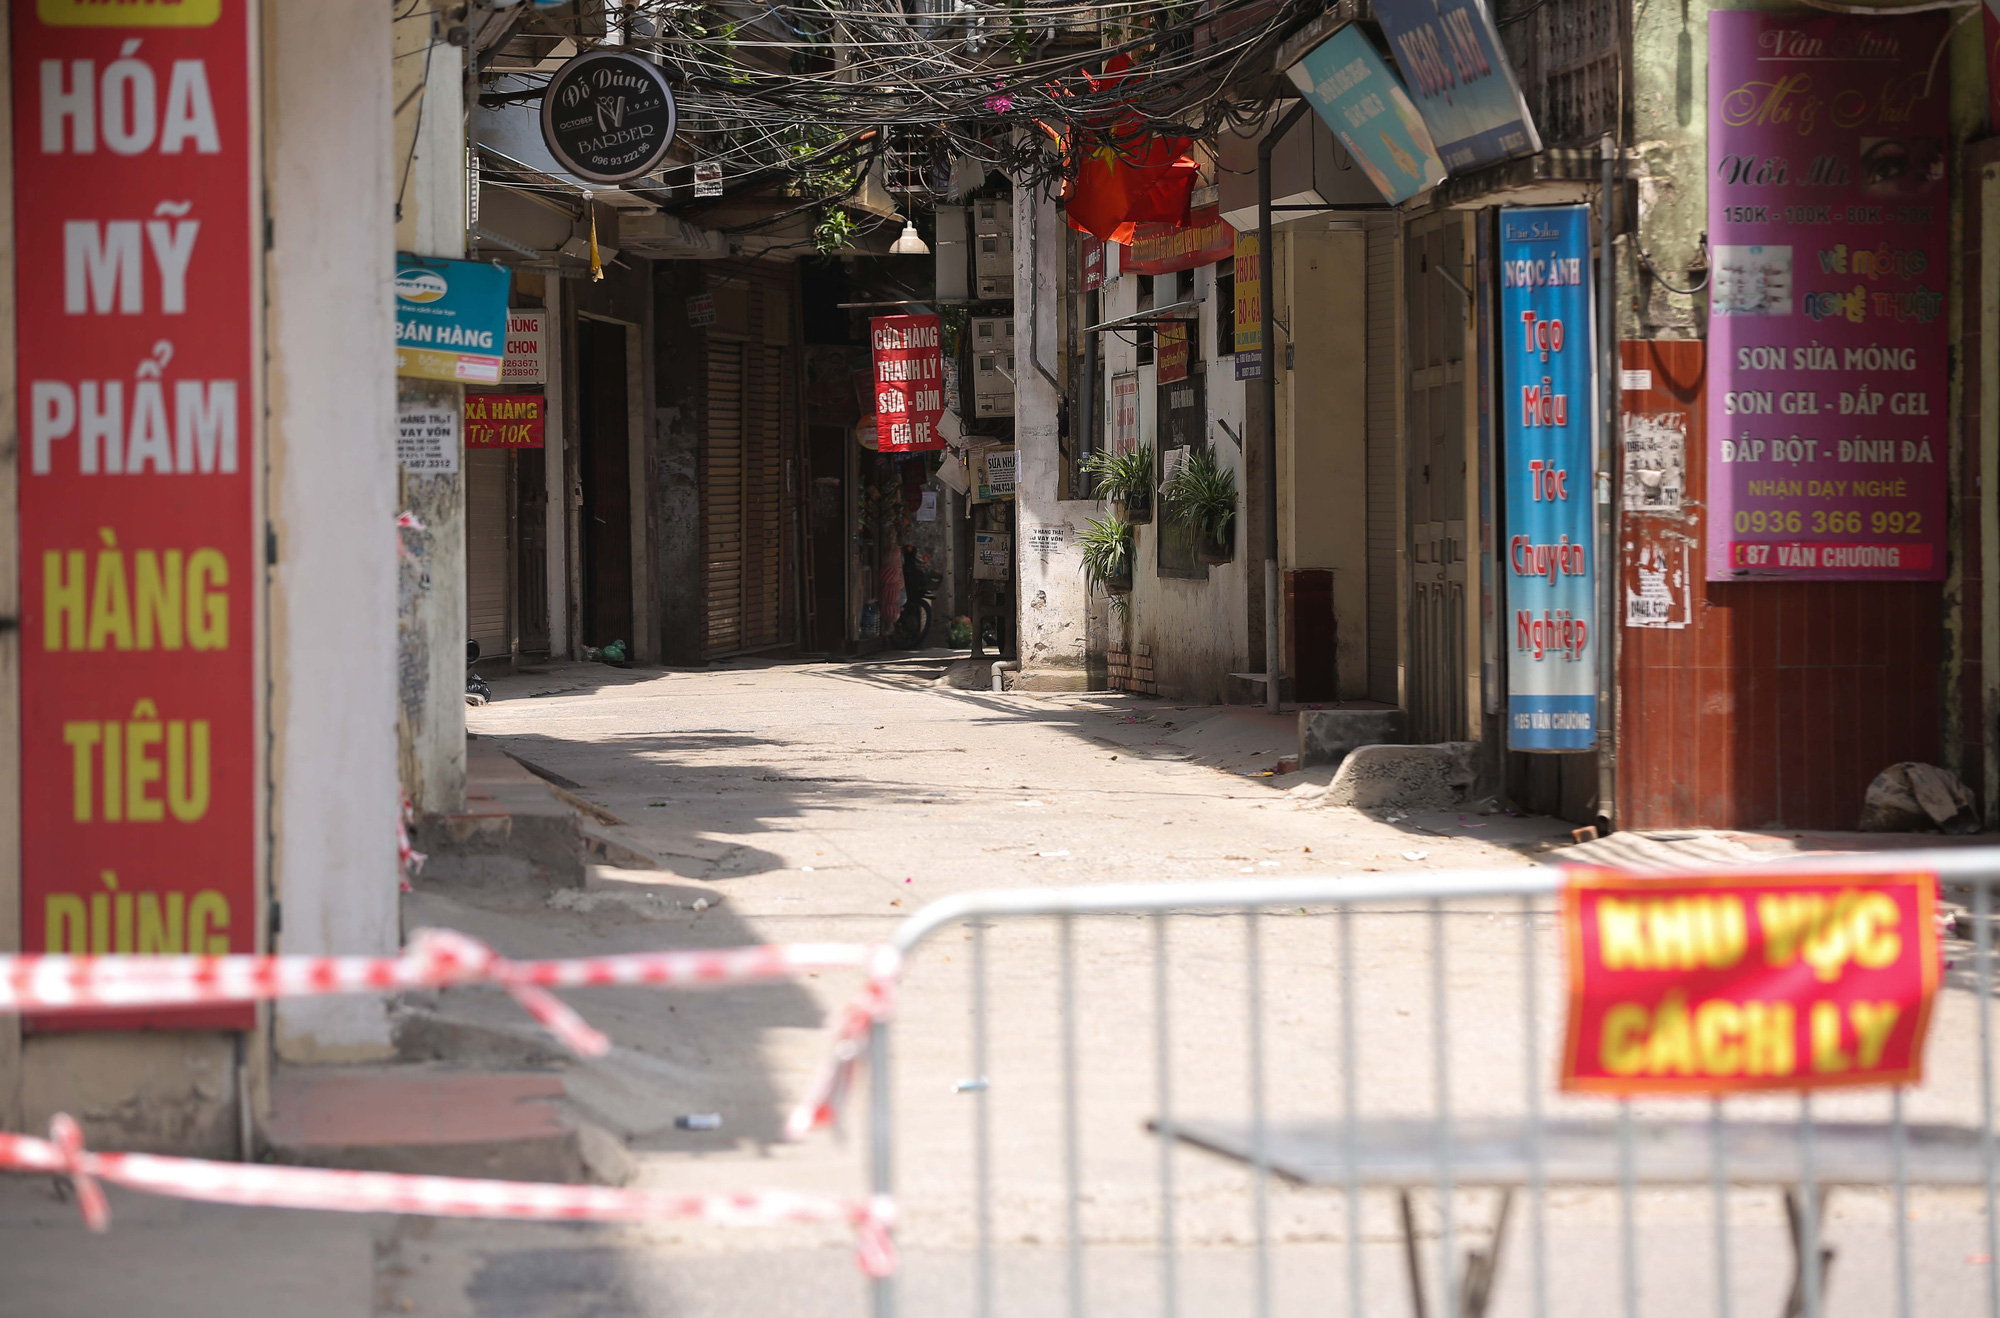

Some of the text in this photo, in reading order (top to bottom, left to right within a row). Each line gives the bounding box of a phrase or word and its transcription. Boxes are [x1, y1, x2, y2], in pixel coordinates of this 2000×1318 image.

[40, 38, 221, 155] HÓA
[562, 68, 649, 108] Đỗ Dũng
[559, 115, 594, 130] OCTOBER
[577, 124, 655, 154] BARBER
[592, 142, 650, 165] 096 93 222 96
[1723, 206, 1768, 223] 150K
[64, 199, 200, 314] MỸ
[1504, 251, 1581, 293] NGỌC ÁNH
[395, 319, 493, 348] BÁN HÀNG
[507, 316, 538, 332] HÙNG
[874, 323, 938, 350] CỬA HÀNG
[1521, 310, 1564, 363] Tạo
[507, 341, 537, 356] CHỌN
[1738, 339, 1917, 371] SƠN SỬA MÓNG
[878, 354, 937, 382] THANH LÝ
[31, 340, 238, 474] PHẨM
[465, 398, 538, 419] XẢ HÀNG
[878, 388, 906, 414] SỮA
[915, 384, 940, 411] BỈM
[1724, 391, 1773, 415] SƠN
[1779, 392, 1818, 415] GEL
[1838, 384, 1885, 415] ĐẮP
[1890, 393, 1930, 415] GEL
[401, 428, 424, 437] VAY
[499, 425, 533, 443] 10K
[891, 419, 912, 445] GIÁ
[915, 416, 932, 443] RẺ
[988, 454, 1002, 469] SỬA
[1720, 431, 1766, 463] ĐẮP
[1771, 435, 1817, 466] BỘT
[1838, 436, 1896, 463] ĐÍNH
[1901, 436, 1934, 463] ĐÁ
[1529, 460, 1567, 501] Tóc
[1748, 477, 1907, 500] NHẬN DẠY NGHỀ
[1734, 511, 1922, 534] 0936 366 992
[1510, 534, 1585, 585] Chuyên
[1777, 543, 1816, 567] VĂN
[1822, 546, 1900, 567] CHƯƠNG
[43, 527, 229, 651] HÀNG
[1517, 609, 1588, 661] Nghiệp
[1531, 709, 1551, 729] VĂN
[1551, 712, 1591, 729] CHƯƠNG
[64, 698, 210, 823] TIÊU
[44, 870, 232, 955] DÙNG
[1597, 891, 1747, 971] KHU
[1600, 986, 1899, 1078] CÁCH LY
